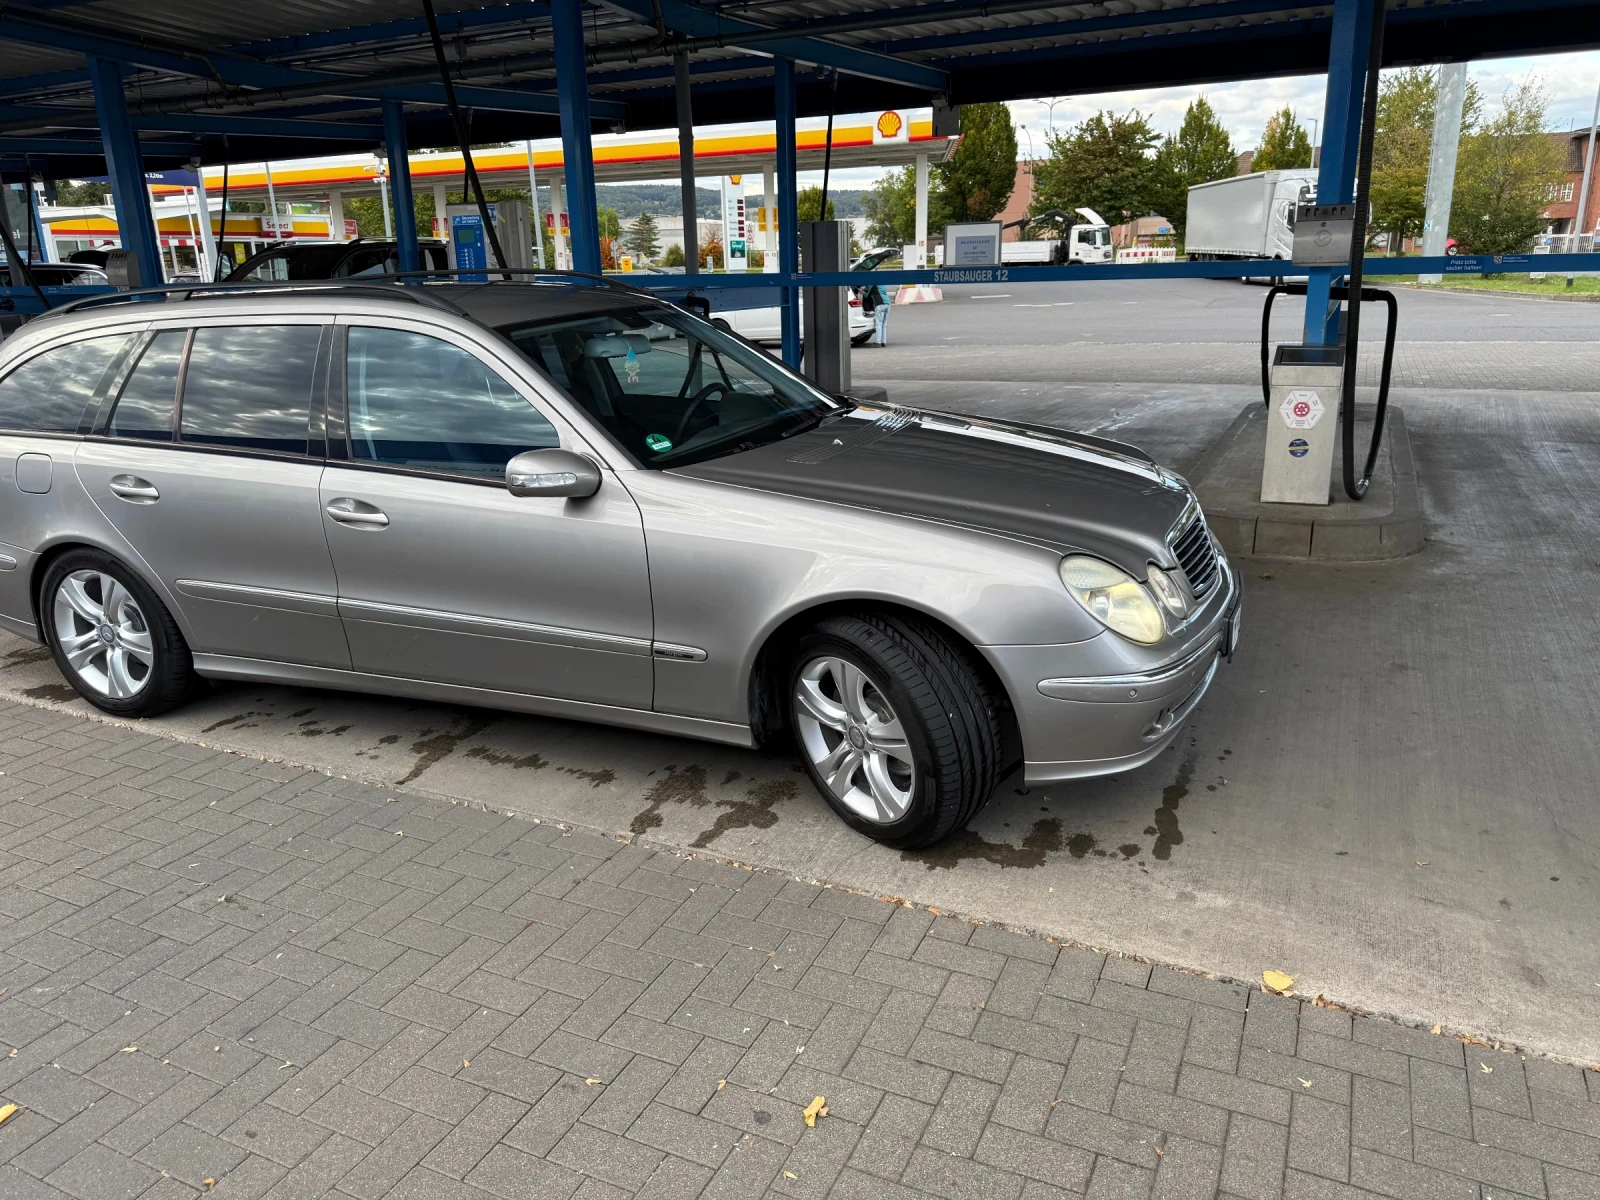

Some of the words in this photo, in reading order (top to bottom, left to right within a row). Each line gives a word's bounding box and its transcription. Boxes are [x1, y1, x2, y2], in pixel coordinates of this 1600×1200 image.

[266, 221, 288, 230] Seect
[933, 270, 992, 282] STAUBSAUGER
[996, 270, 1009, 281] 12
[652, 434, 661, 443] 4
